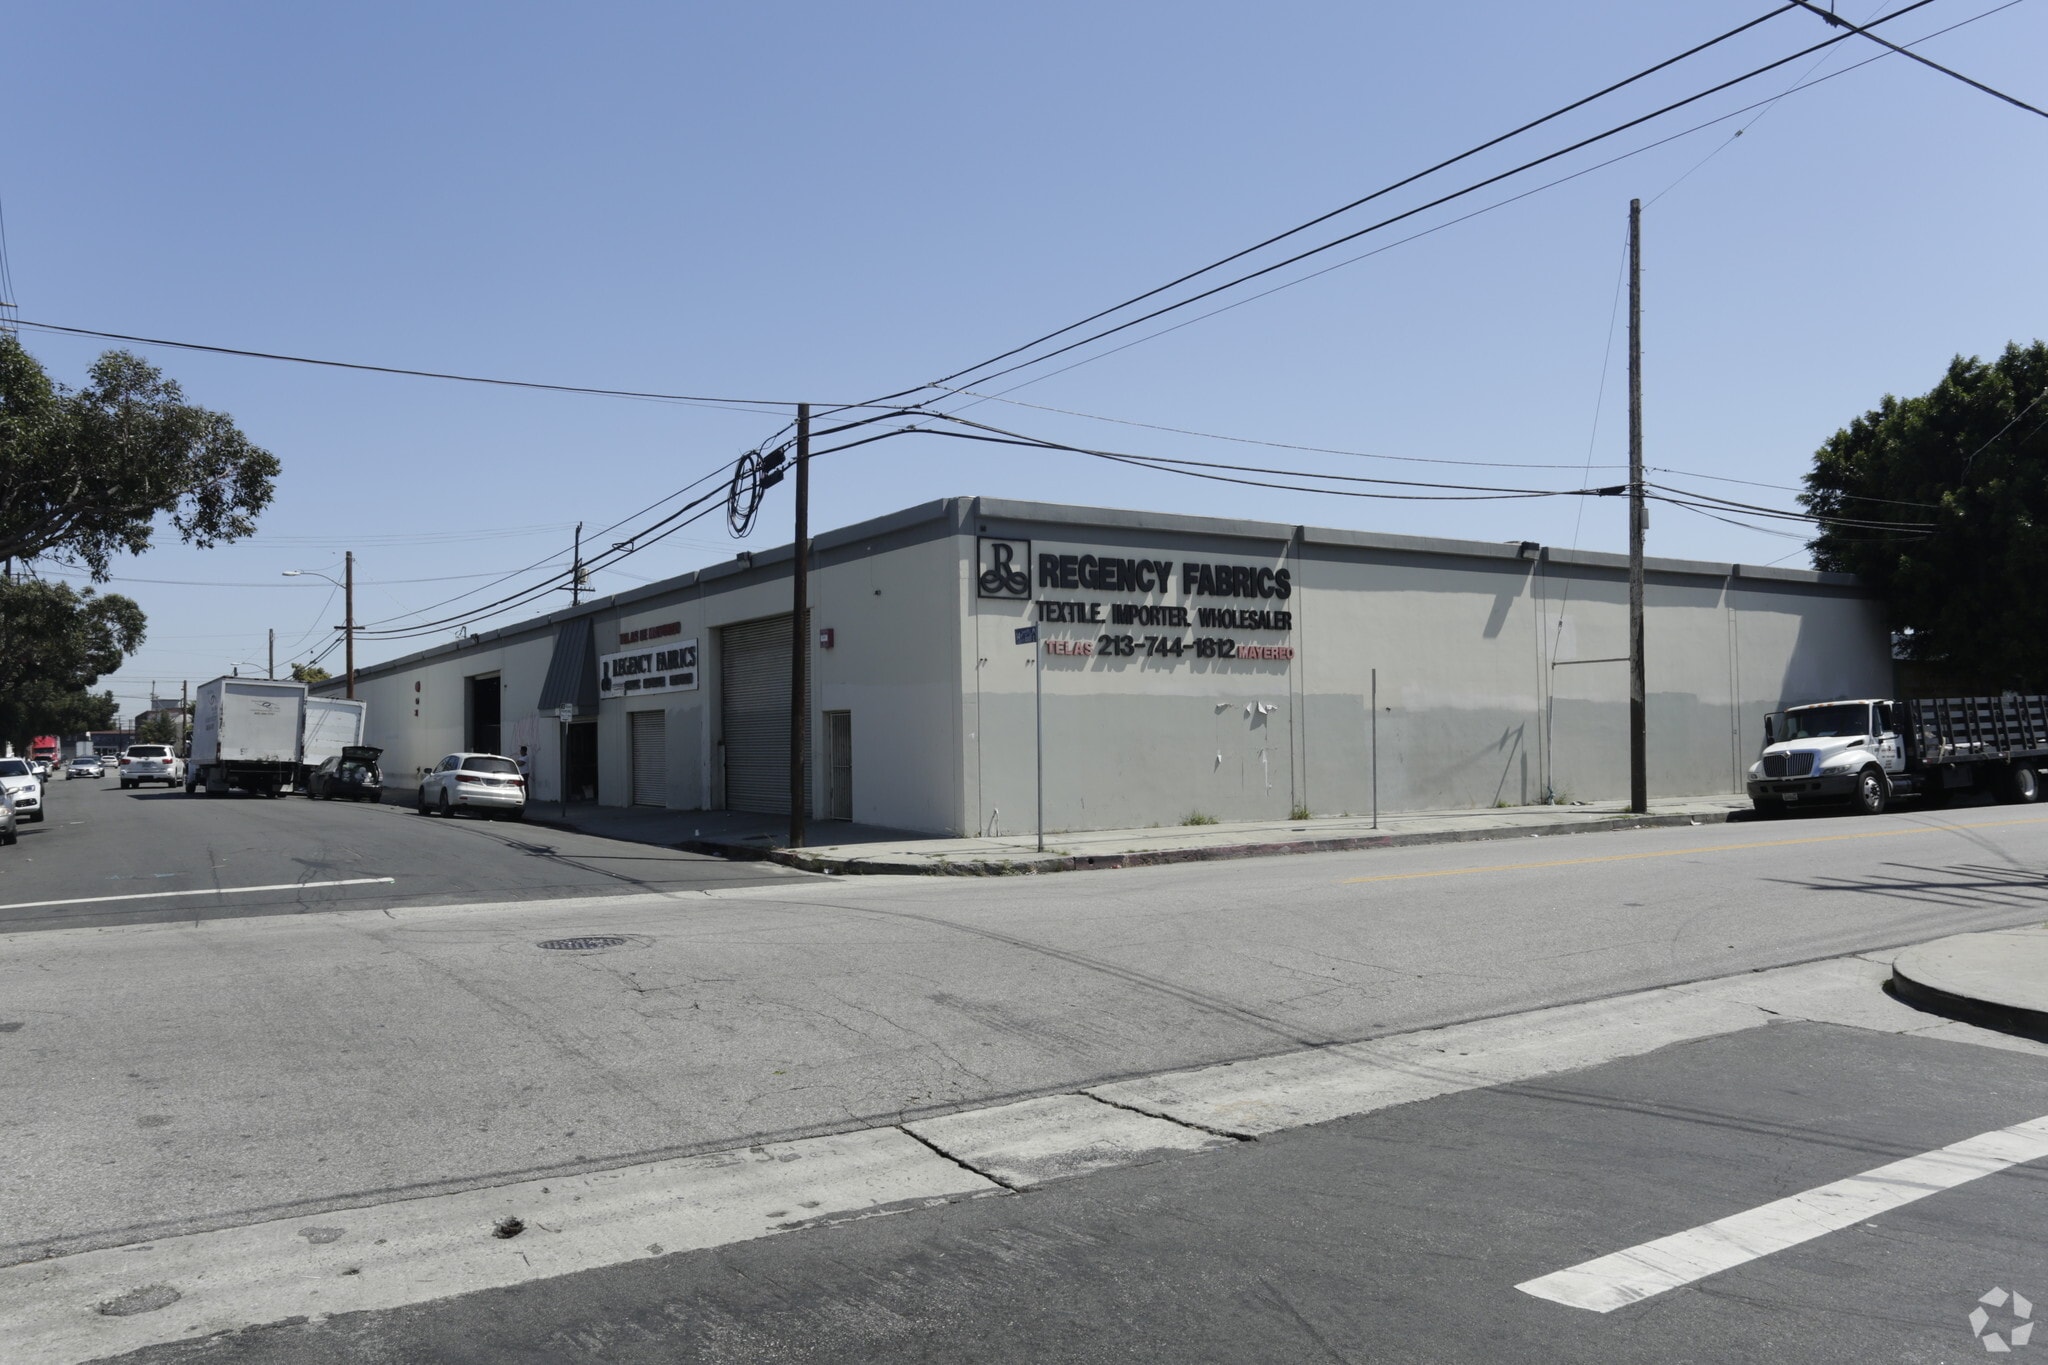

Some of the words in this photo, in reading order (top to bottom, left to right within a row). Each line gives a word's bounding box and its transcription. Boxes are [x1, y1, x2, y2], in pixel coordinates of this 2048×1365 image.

[1039, 553, 1172, 593] REGENCY
[1183, 563, 1291, 600] FABRICS
[1198, 608, 1292, 630] WHOLESALER
[1044, 640, 1093, 656] TELAS
[1098, 634, 1236, 658] 213-744-1812
[1237, 646, 1295, 660] MAYEREO
